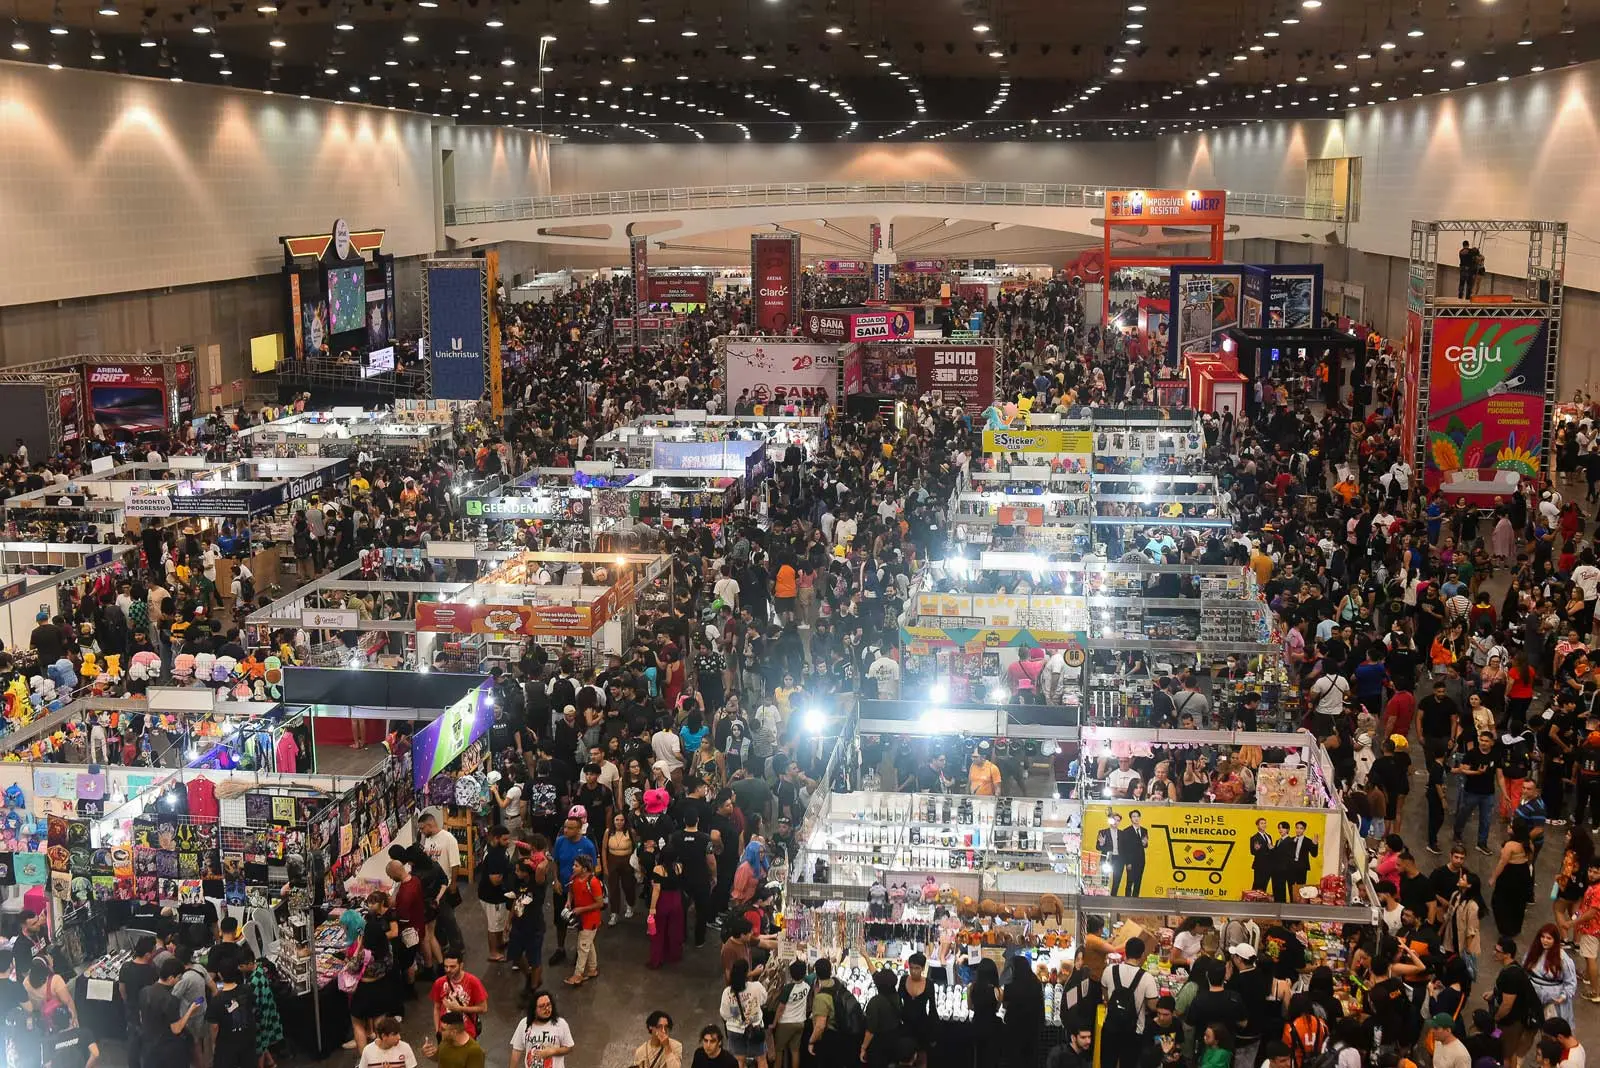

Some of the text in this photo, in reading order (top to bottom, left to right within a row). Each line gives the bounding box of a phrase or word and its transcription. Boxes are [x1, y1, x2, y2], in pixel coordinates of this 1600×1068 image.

[1191, 198, 1220, 212] QUER?
[1150, 207, 1180, 216] RESISTIR
[760, 286, 787, 297] Claro
[820, 318, 844, 330] SANA
[874, 316, 885, 324] DO
[856, 326, 887, 337] SANA
[435, 350, 480, 359] Unichristus
[934, 351, 976, 366] SANA
[1445, 341, 1501, 376] caju
[90, 373, 131, 382] DRIFT
[774, 386, 829, 398] SANA
[994, 433, 1001, 445] MY
[1001, 433, 1034, 446] Sticker
[1184, 814, 1225, 826] 우리마트
[1190, 828, 1237, 836] MERCADO
[1168, 886, 1228, 896] imercado_br
[792, 987, 808, 1002] 230
